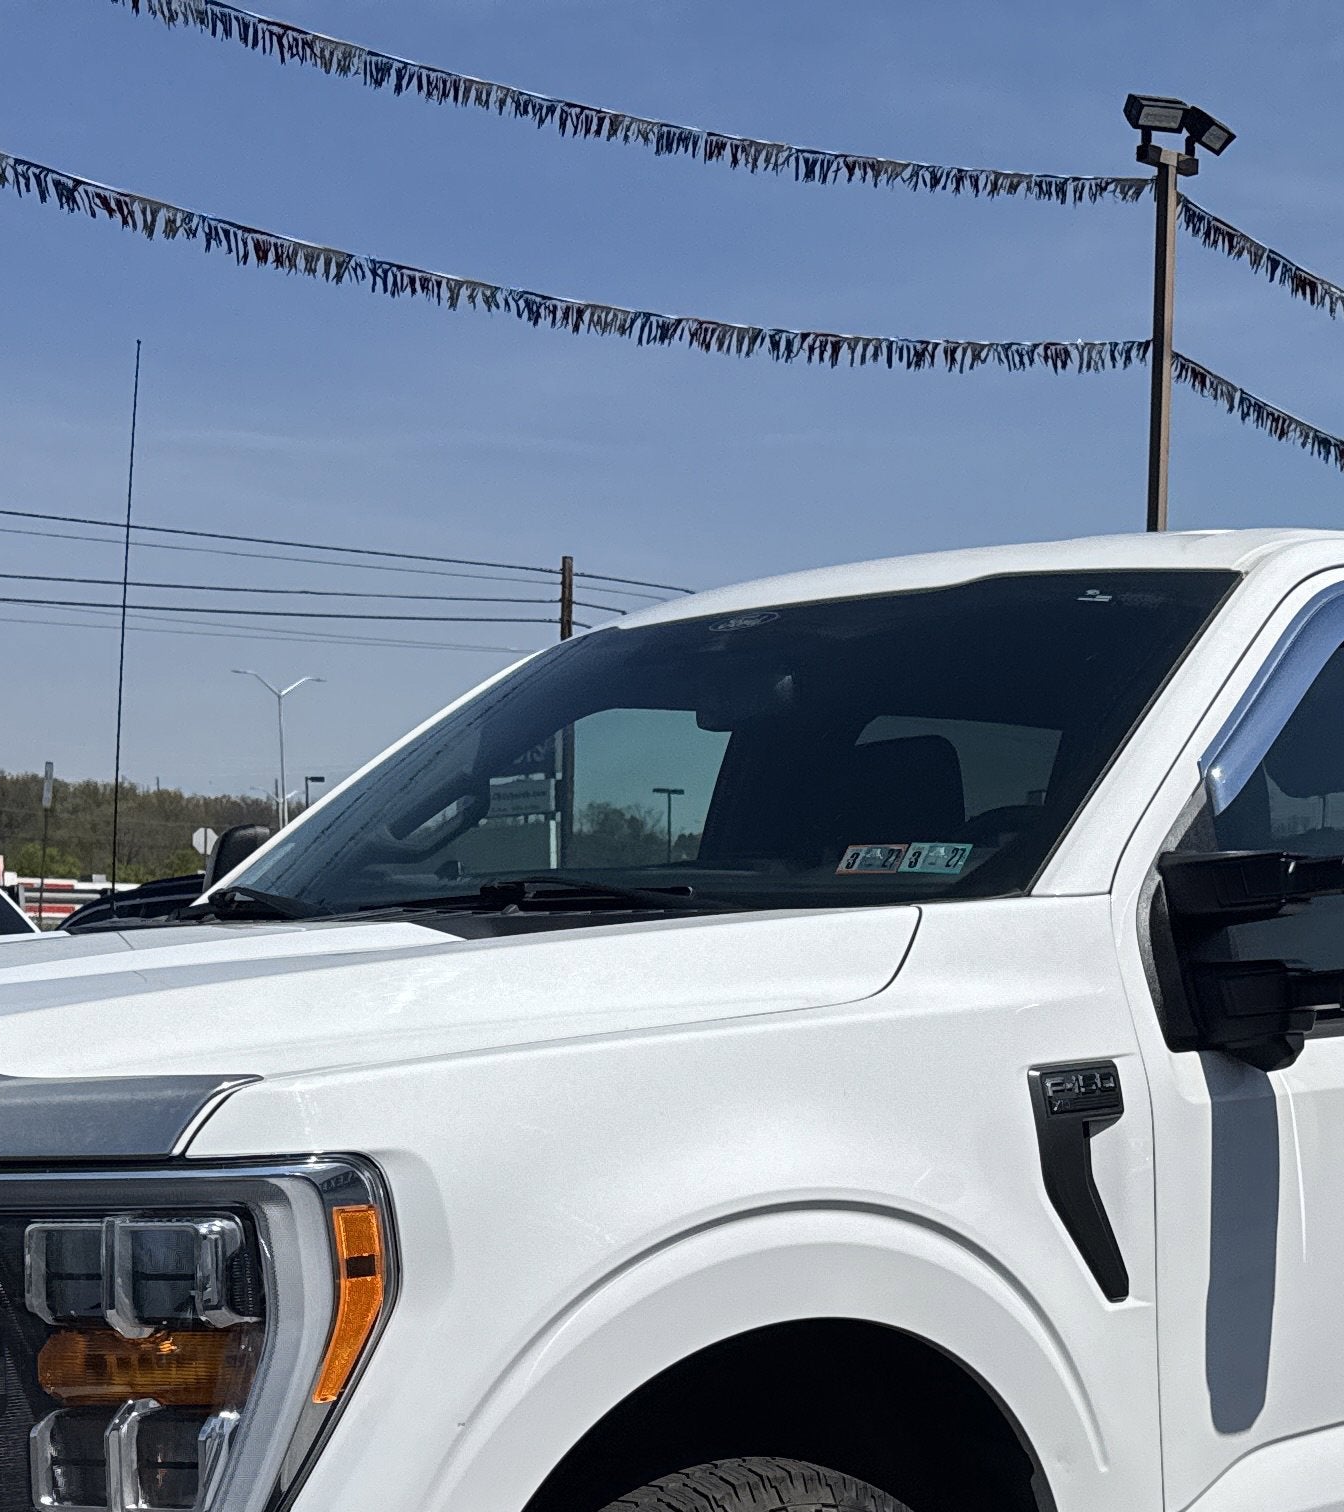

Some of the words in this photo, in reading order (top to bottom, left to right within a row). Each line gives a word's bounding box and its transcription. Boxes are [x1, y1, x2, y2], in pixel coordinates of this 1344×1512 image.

[845, 852, 860, 869] 3
[882, 849, 902, 869] 27
[908, 850, 922, 869] 3
[945, 848, 966, 869] 27
